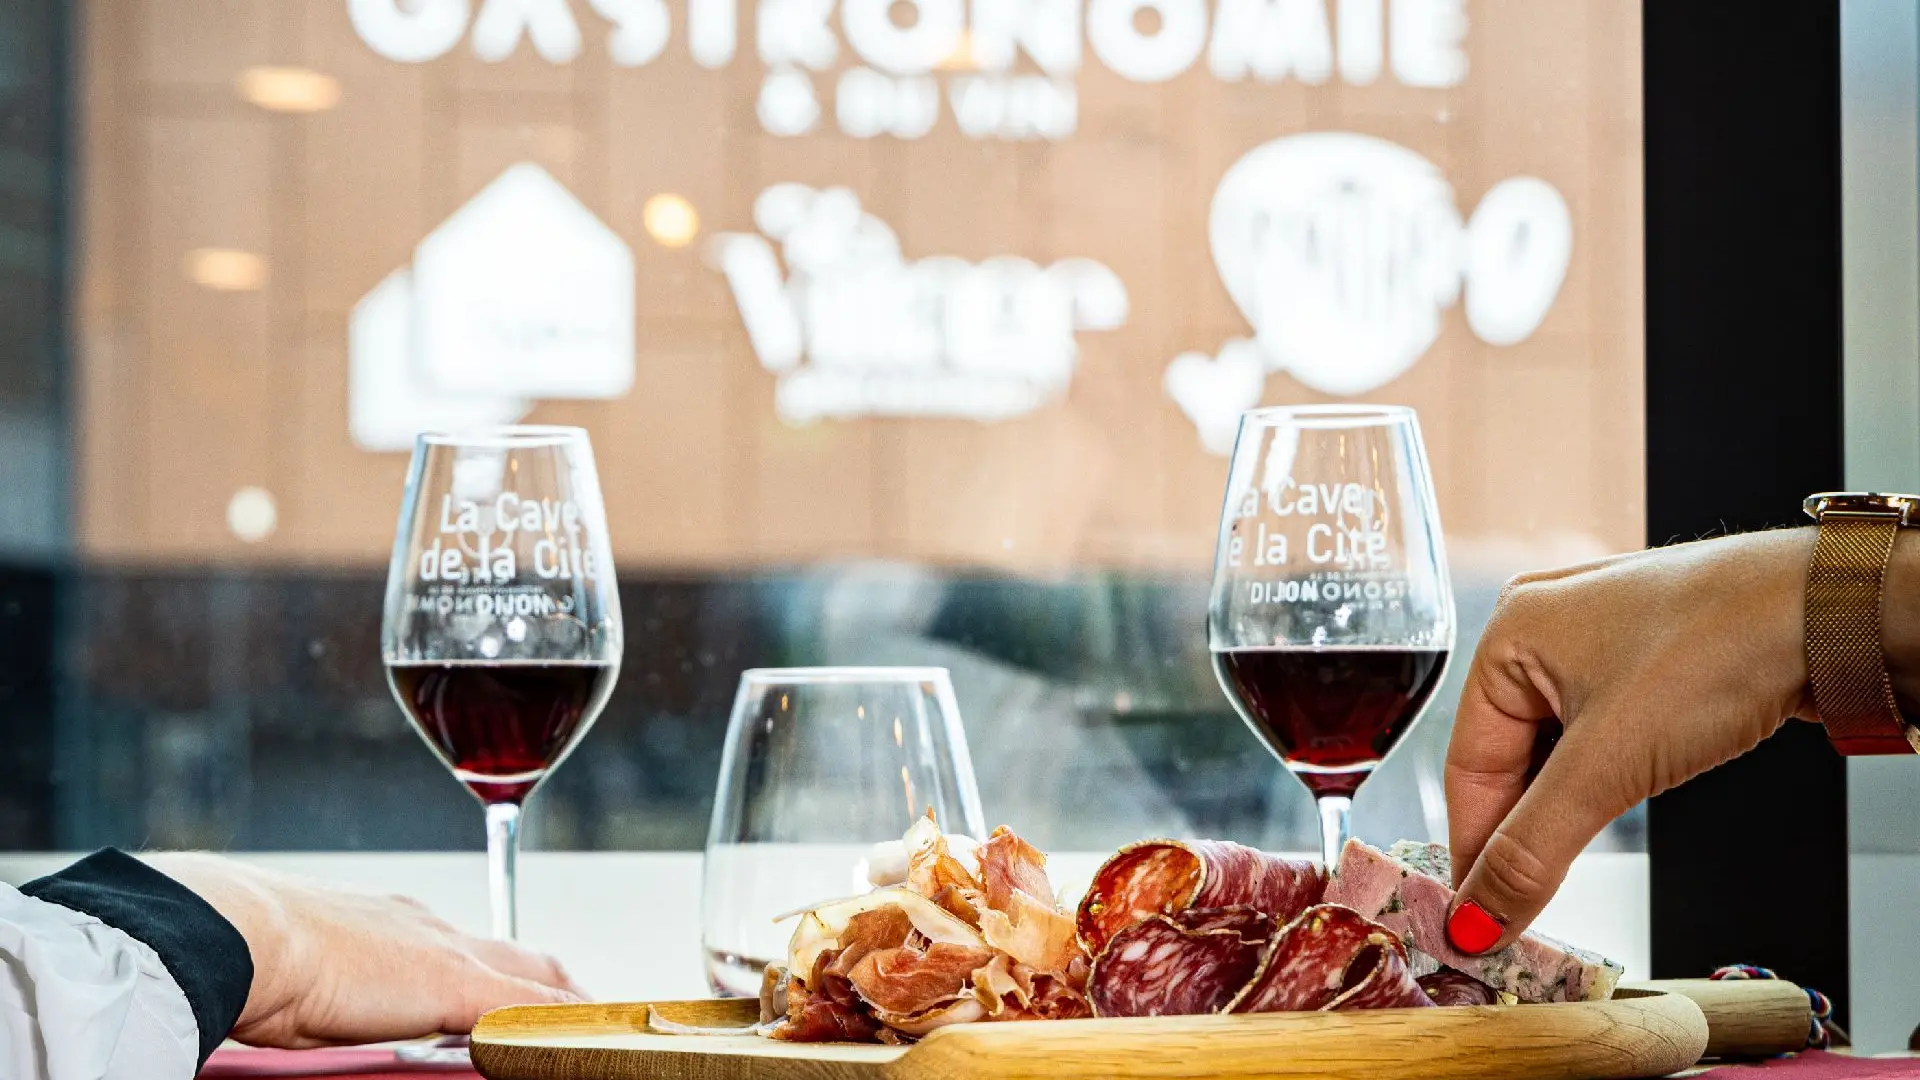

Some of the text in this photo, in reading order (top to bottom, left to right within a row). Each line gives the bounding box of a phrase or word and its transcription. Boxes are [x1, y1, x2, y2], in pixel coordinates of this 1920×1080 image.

[440, 492, 581, 533] La Cave
[1273, 477, 1363, 516] Cave
[420, 538, 461, 580] de
[478, 536, 516, 580] la
[1254, 523, 1288, 566] la
[1250, 580, 1317, 604] DIJON
